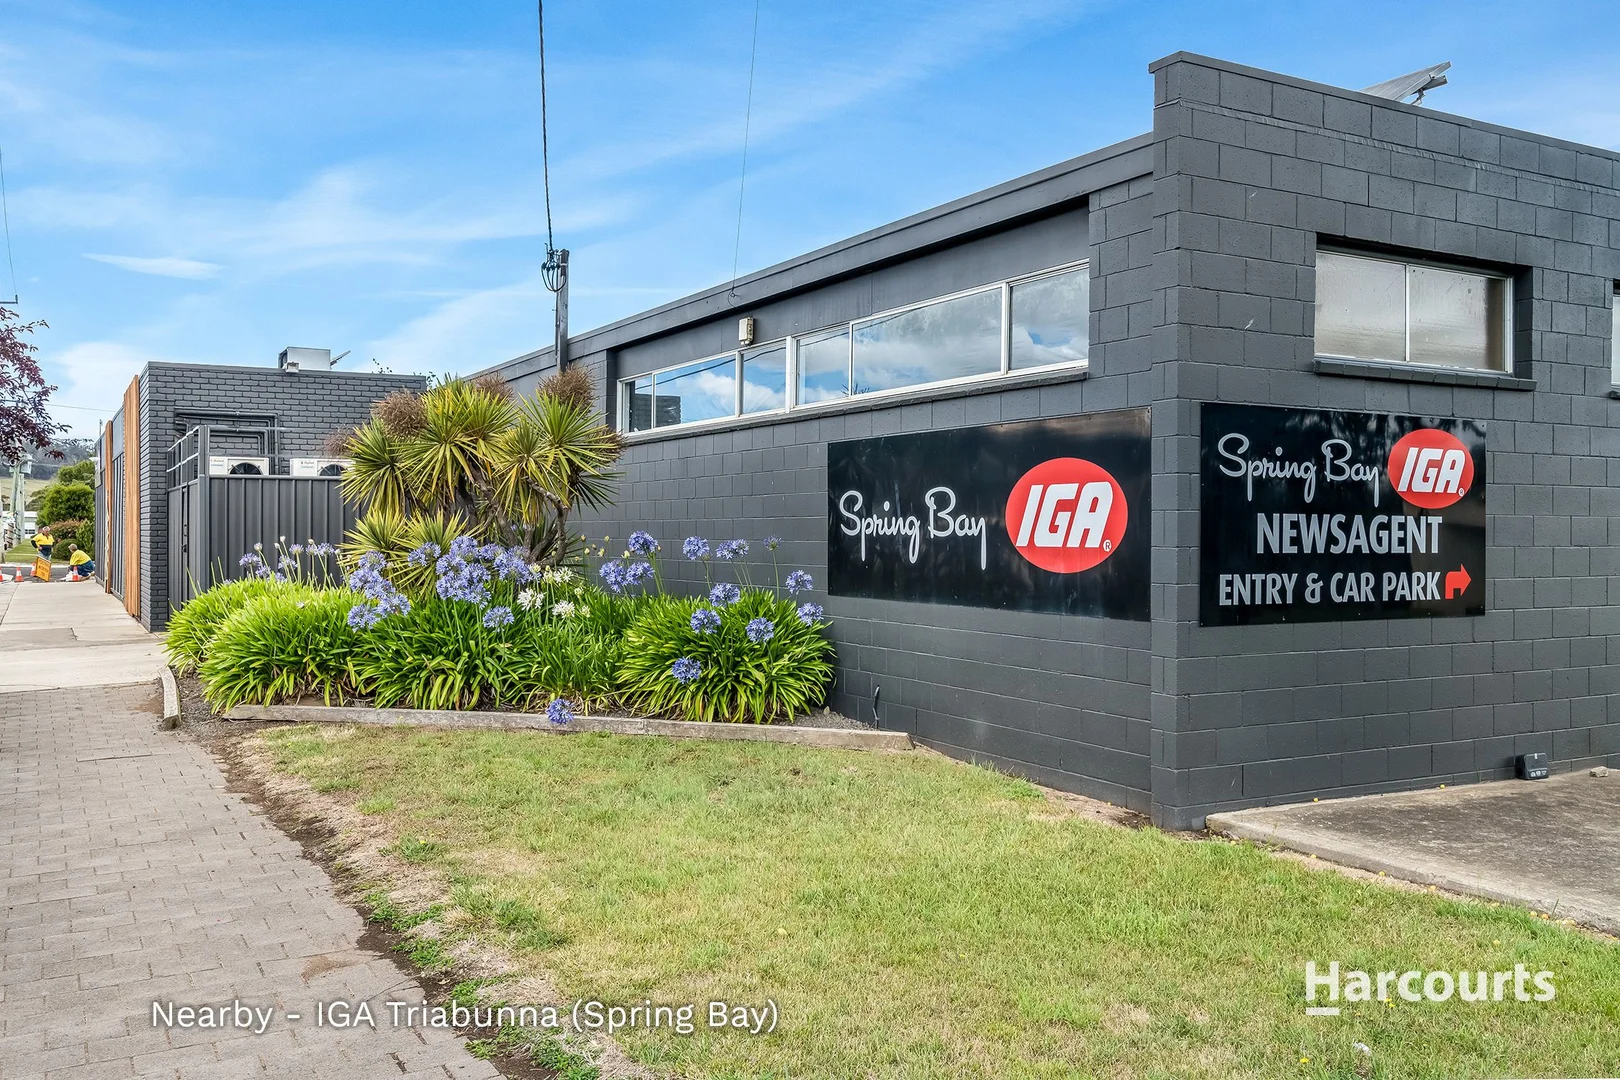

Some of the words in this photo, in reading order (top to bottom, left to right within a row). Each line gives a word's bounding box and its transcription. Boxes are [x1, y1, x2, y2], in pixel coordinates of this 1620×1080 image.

[1217, 432, 1317, 503] Spring
[1321, 439, 1380, 507] Bay
[1397, 447, 1466, 494] IGA
[839, 490, 921, 564] Spring
[924, 486, 987, 570] Bay
[1015, 481, 1113, 549] IGA
[1256, 512, 1443, 554] NEWSAGENT
[1218, 573, 1299, 606] ENTRY
[1304, 572, 1324, 603] &
[1330, 571, 1375, 602] CAR
[1382, 571, 1441, 601] PARK
